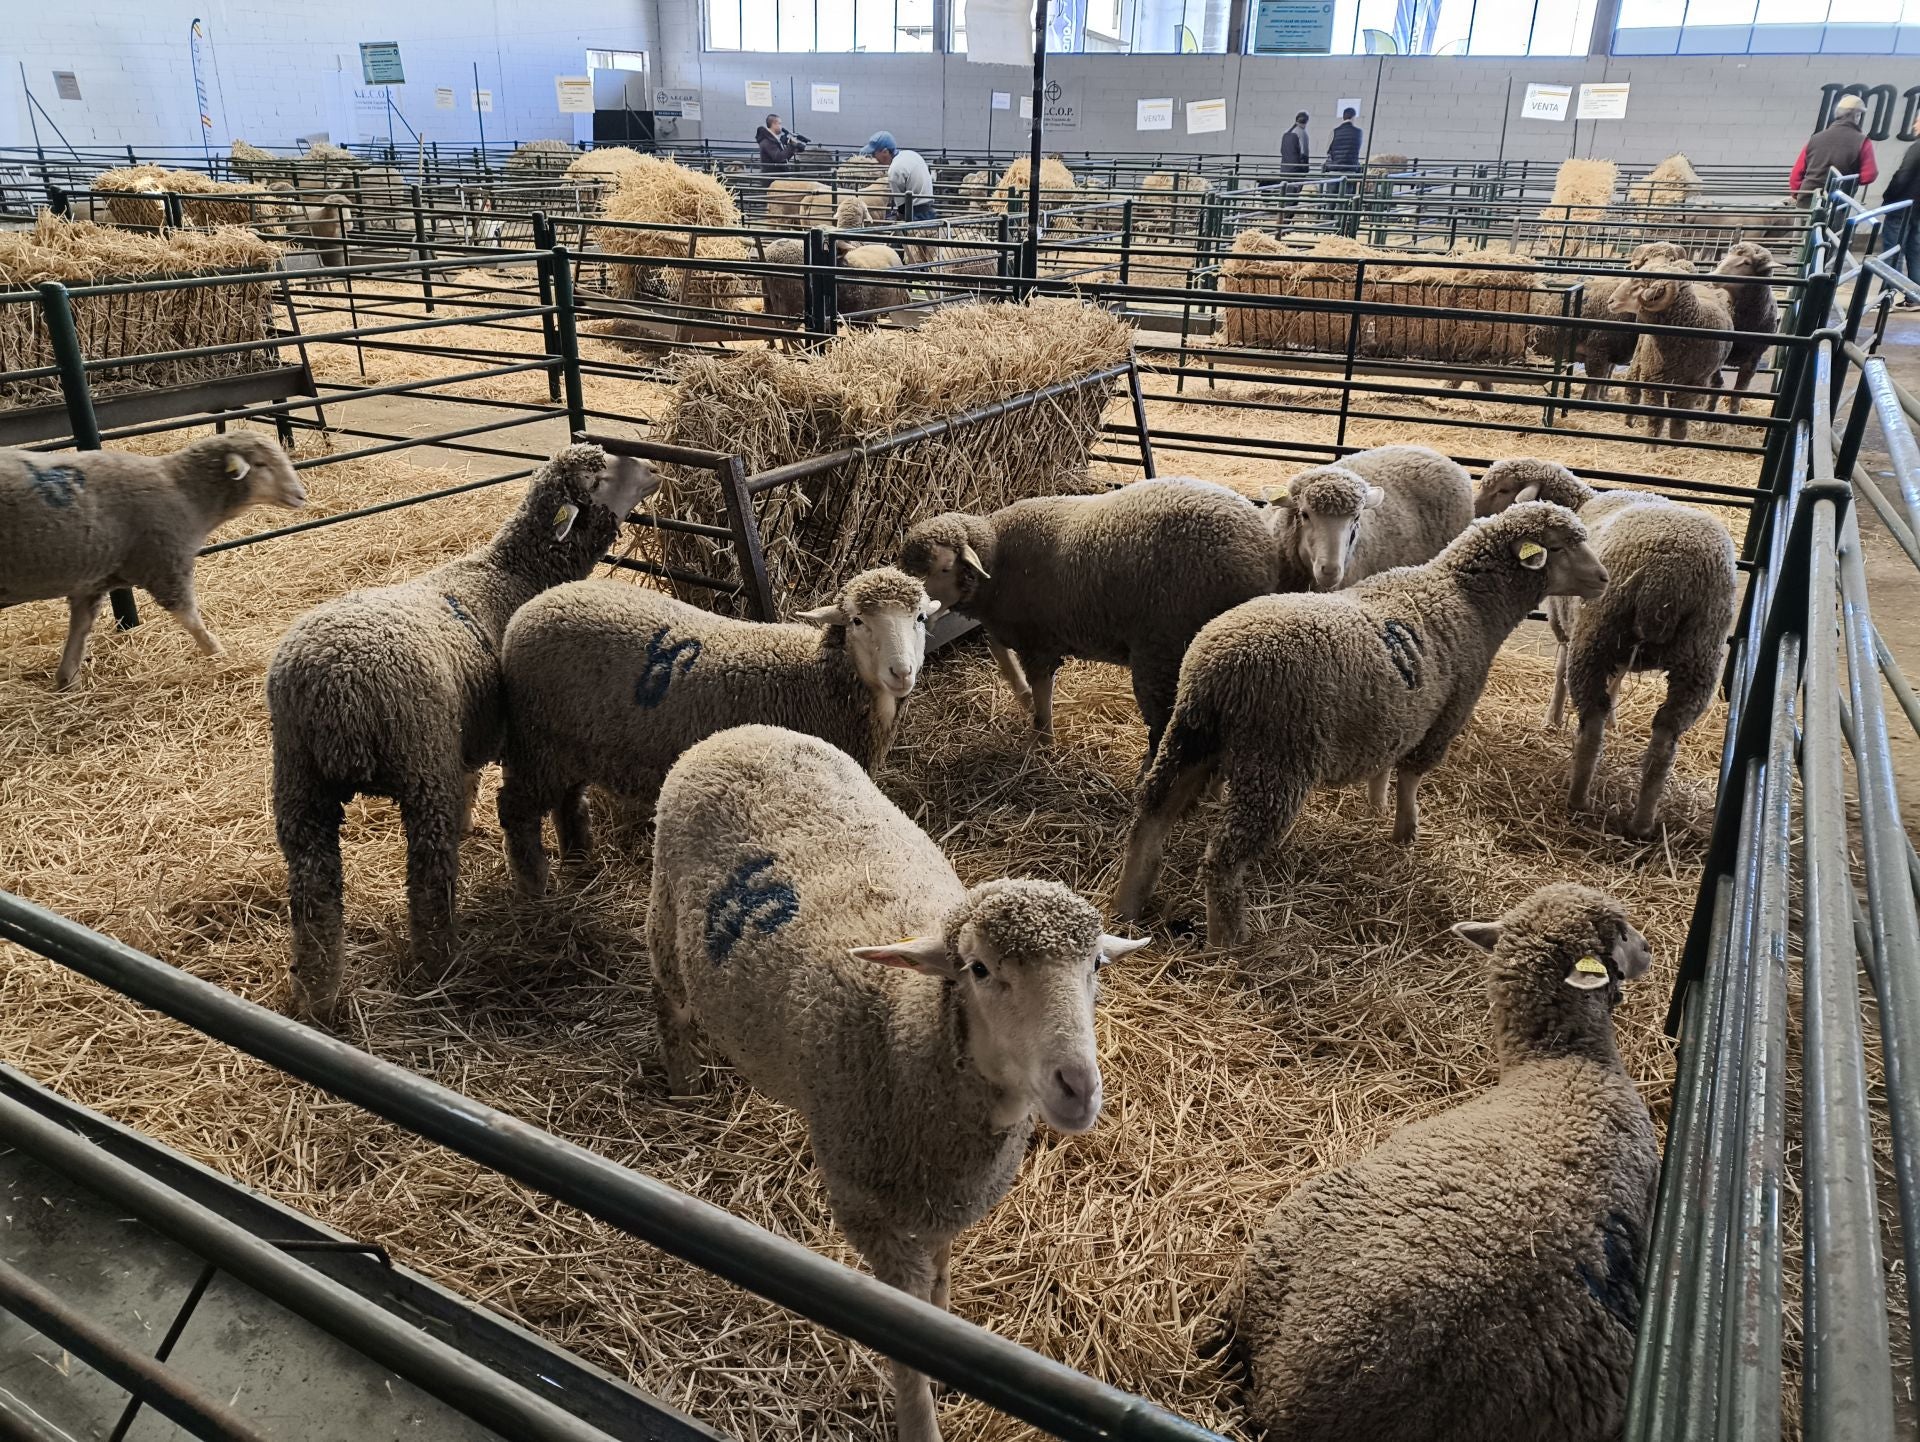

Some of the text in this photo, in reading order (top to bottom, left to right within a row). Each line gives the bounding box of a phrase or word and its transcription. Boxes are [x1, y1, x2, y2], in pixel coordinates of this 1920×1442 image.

[816, 97, 834, 105] VENTA
[1531, 101, 1559, 112] VENTA
[1143, 113, 1166, 122] VENTA
